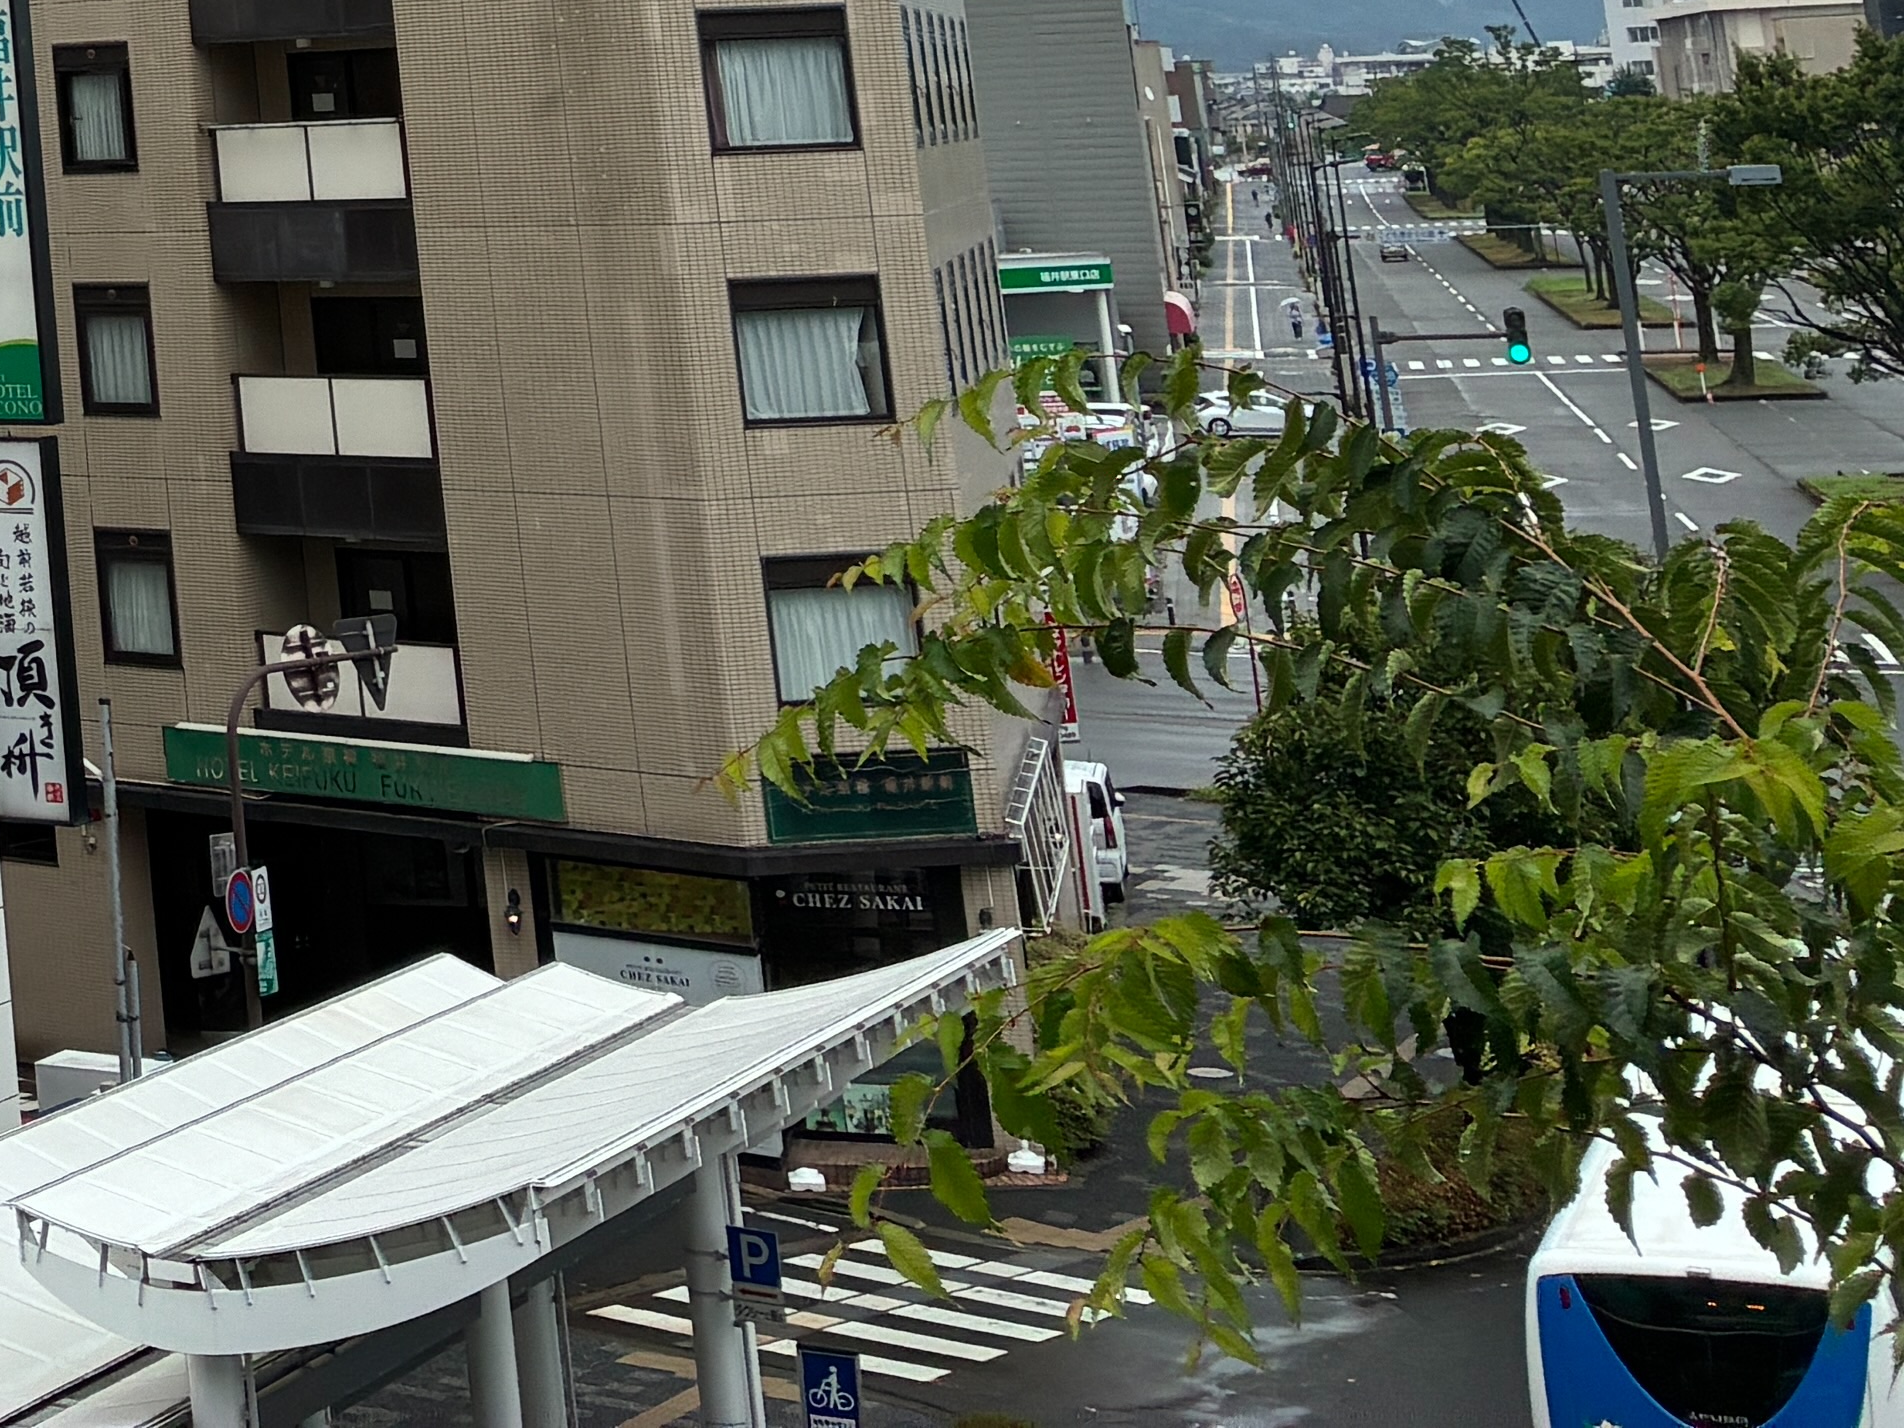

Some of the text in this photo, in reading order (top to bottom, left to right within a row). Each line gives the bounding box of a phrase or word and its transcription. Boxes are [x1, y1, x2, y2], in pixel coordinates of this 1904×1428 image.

[196, 756, 258, 783] HOEL
[792, 892, 925, 911] CHEZ SAKAI
[619, 968, 653, 983] CHEZ
[656, 973, 691, 988] SAKAI
[739, 1233, 769, 1279] P
